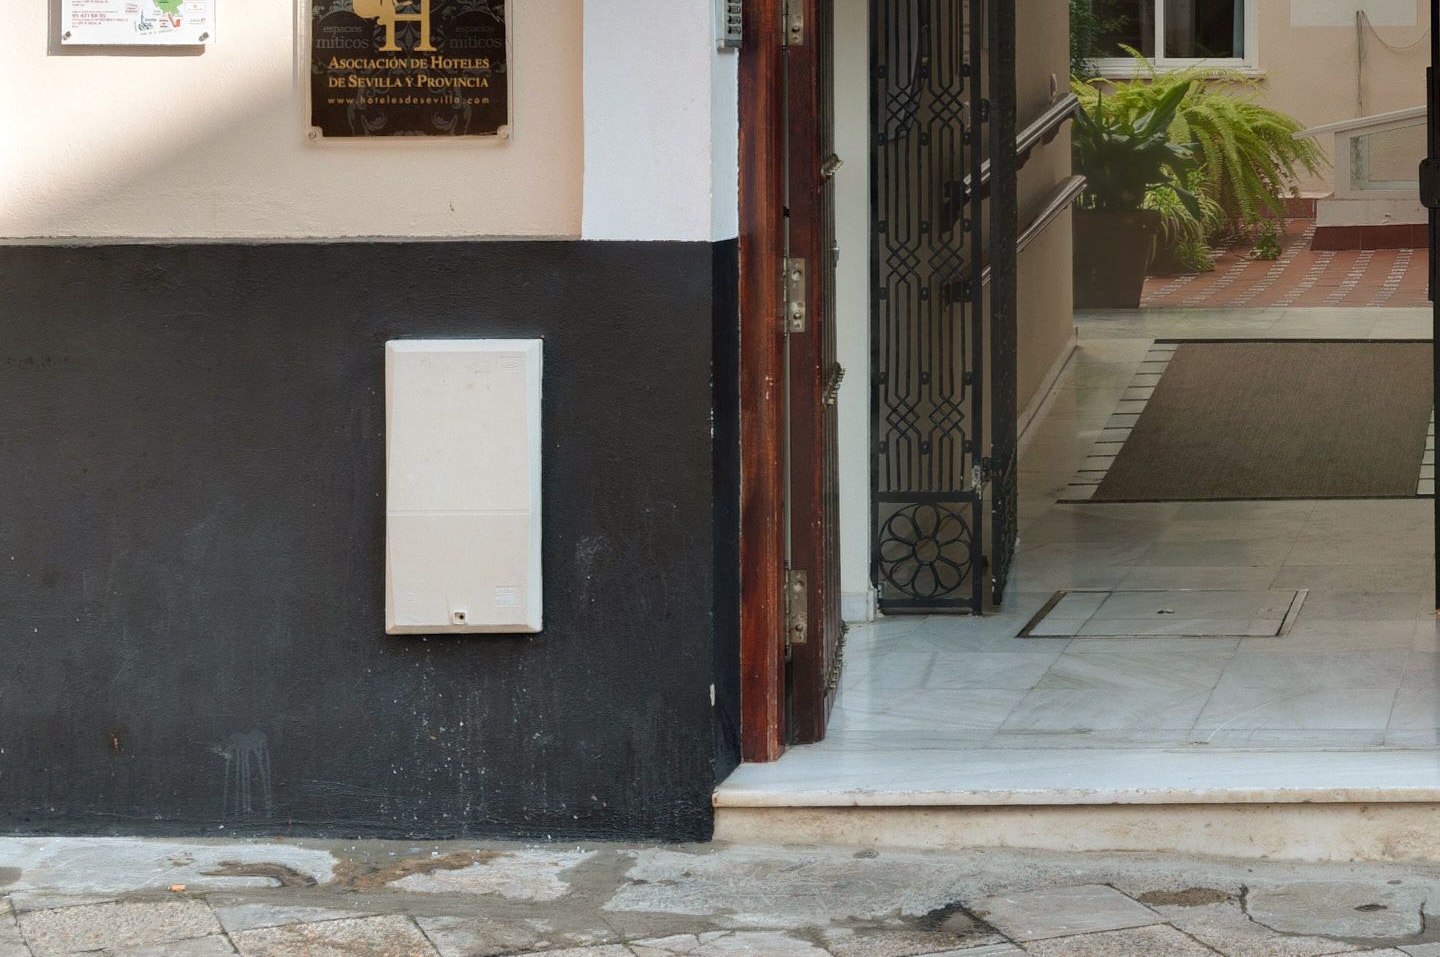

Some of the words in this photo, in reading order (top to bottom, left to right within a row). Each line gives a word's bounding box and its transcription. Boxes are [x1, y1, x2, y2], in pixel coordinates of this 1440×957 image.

[328, 56, 406, 70] ASOCIACIÓN
[410, 58, 428, 69] DE
[431, 56, 490, 69] HOTELES
[328, 77, 346, 88] DE
[348, 75, 402, 88] SEVILLA
[405, 77, 414, 88] Y
[417, 75, 489, 88] PROVINCIA
[328, 95, 490, 105] www.hotelesdesevilla.com
